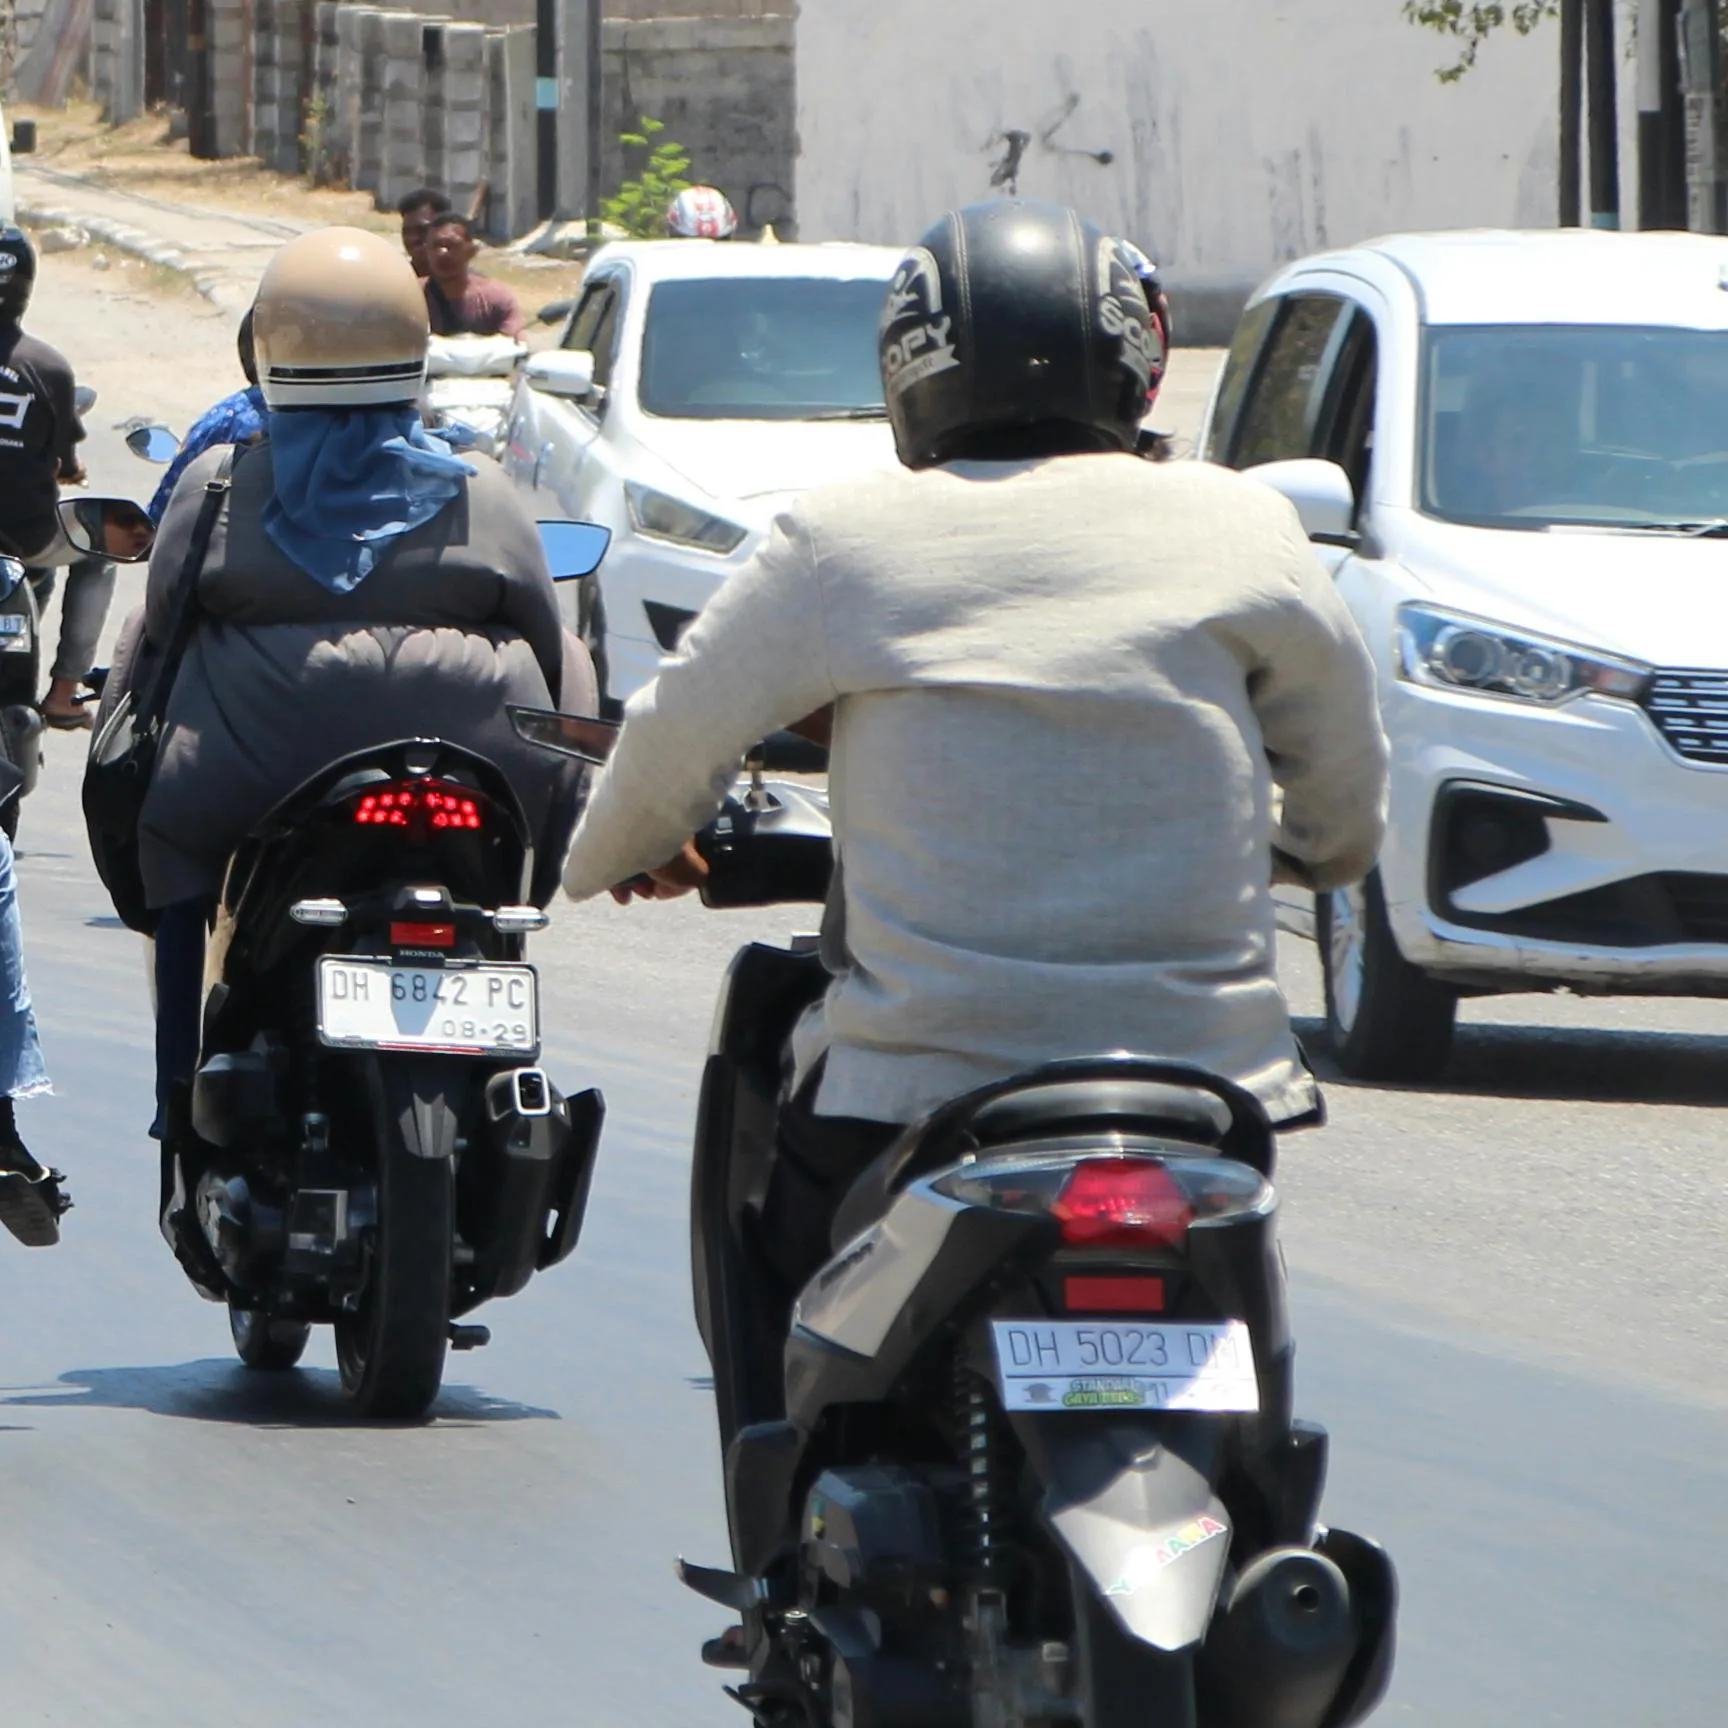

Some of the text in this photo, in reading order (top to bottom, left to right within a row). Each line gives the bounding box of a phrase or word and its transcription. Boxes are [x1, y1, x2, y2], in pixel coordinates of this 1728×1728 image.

[399, 949, 445, 959] HONDA
[331, 969, 526, 1010] DH 6842 PC
[1007, 1329, 1060, 1368] DH
[1076, 1330, 1169, 1368] 5023
